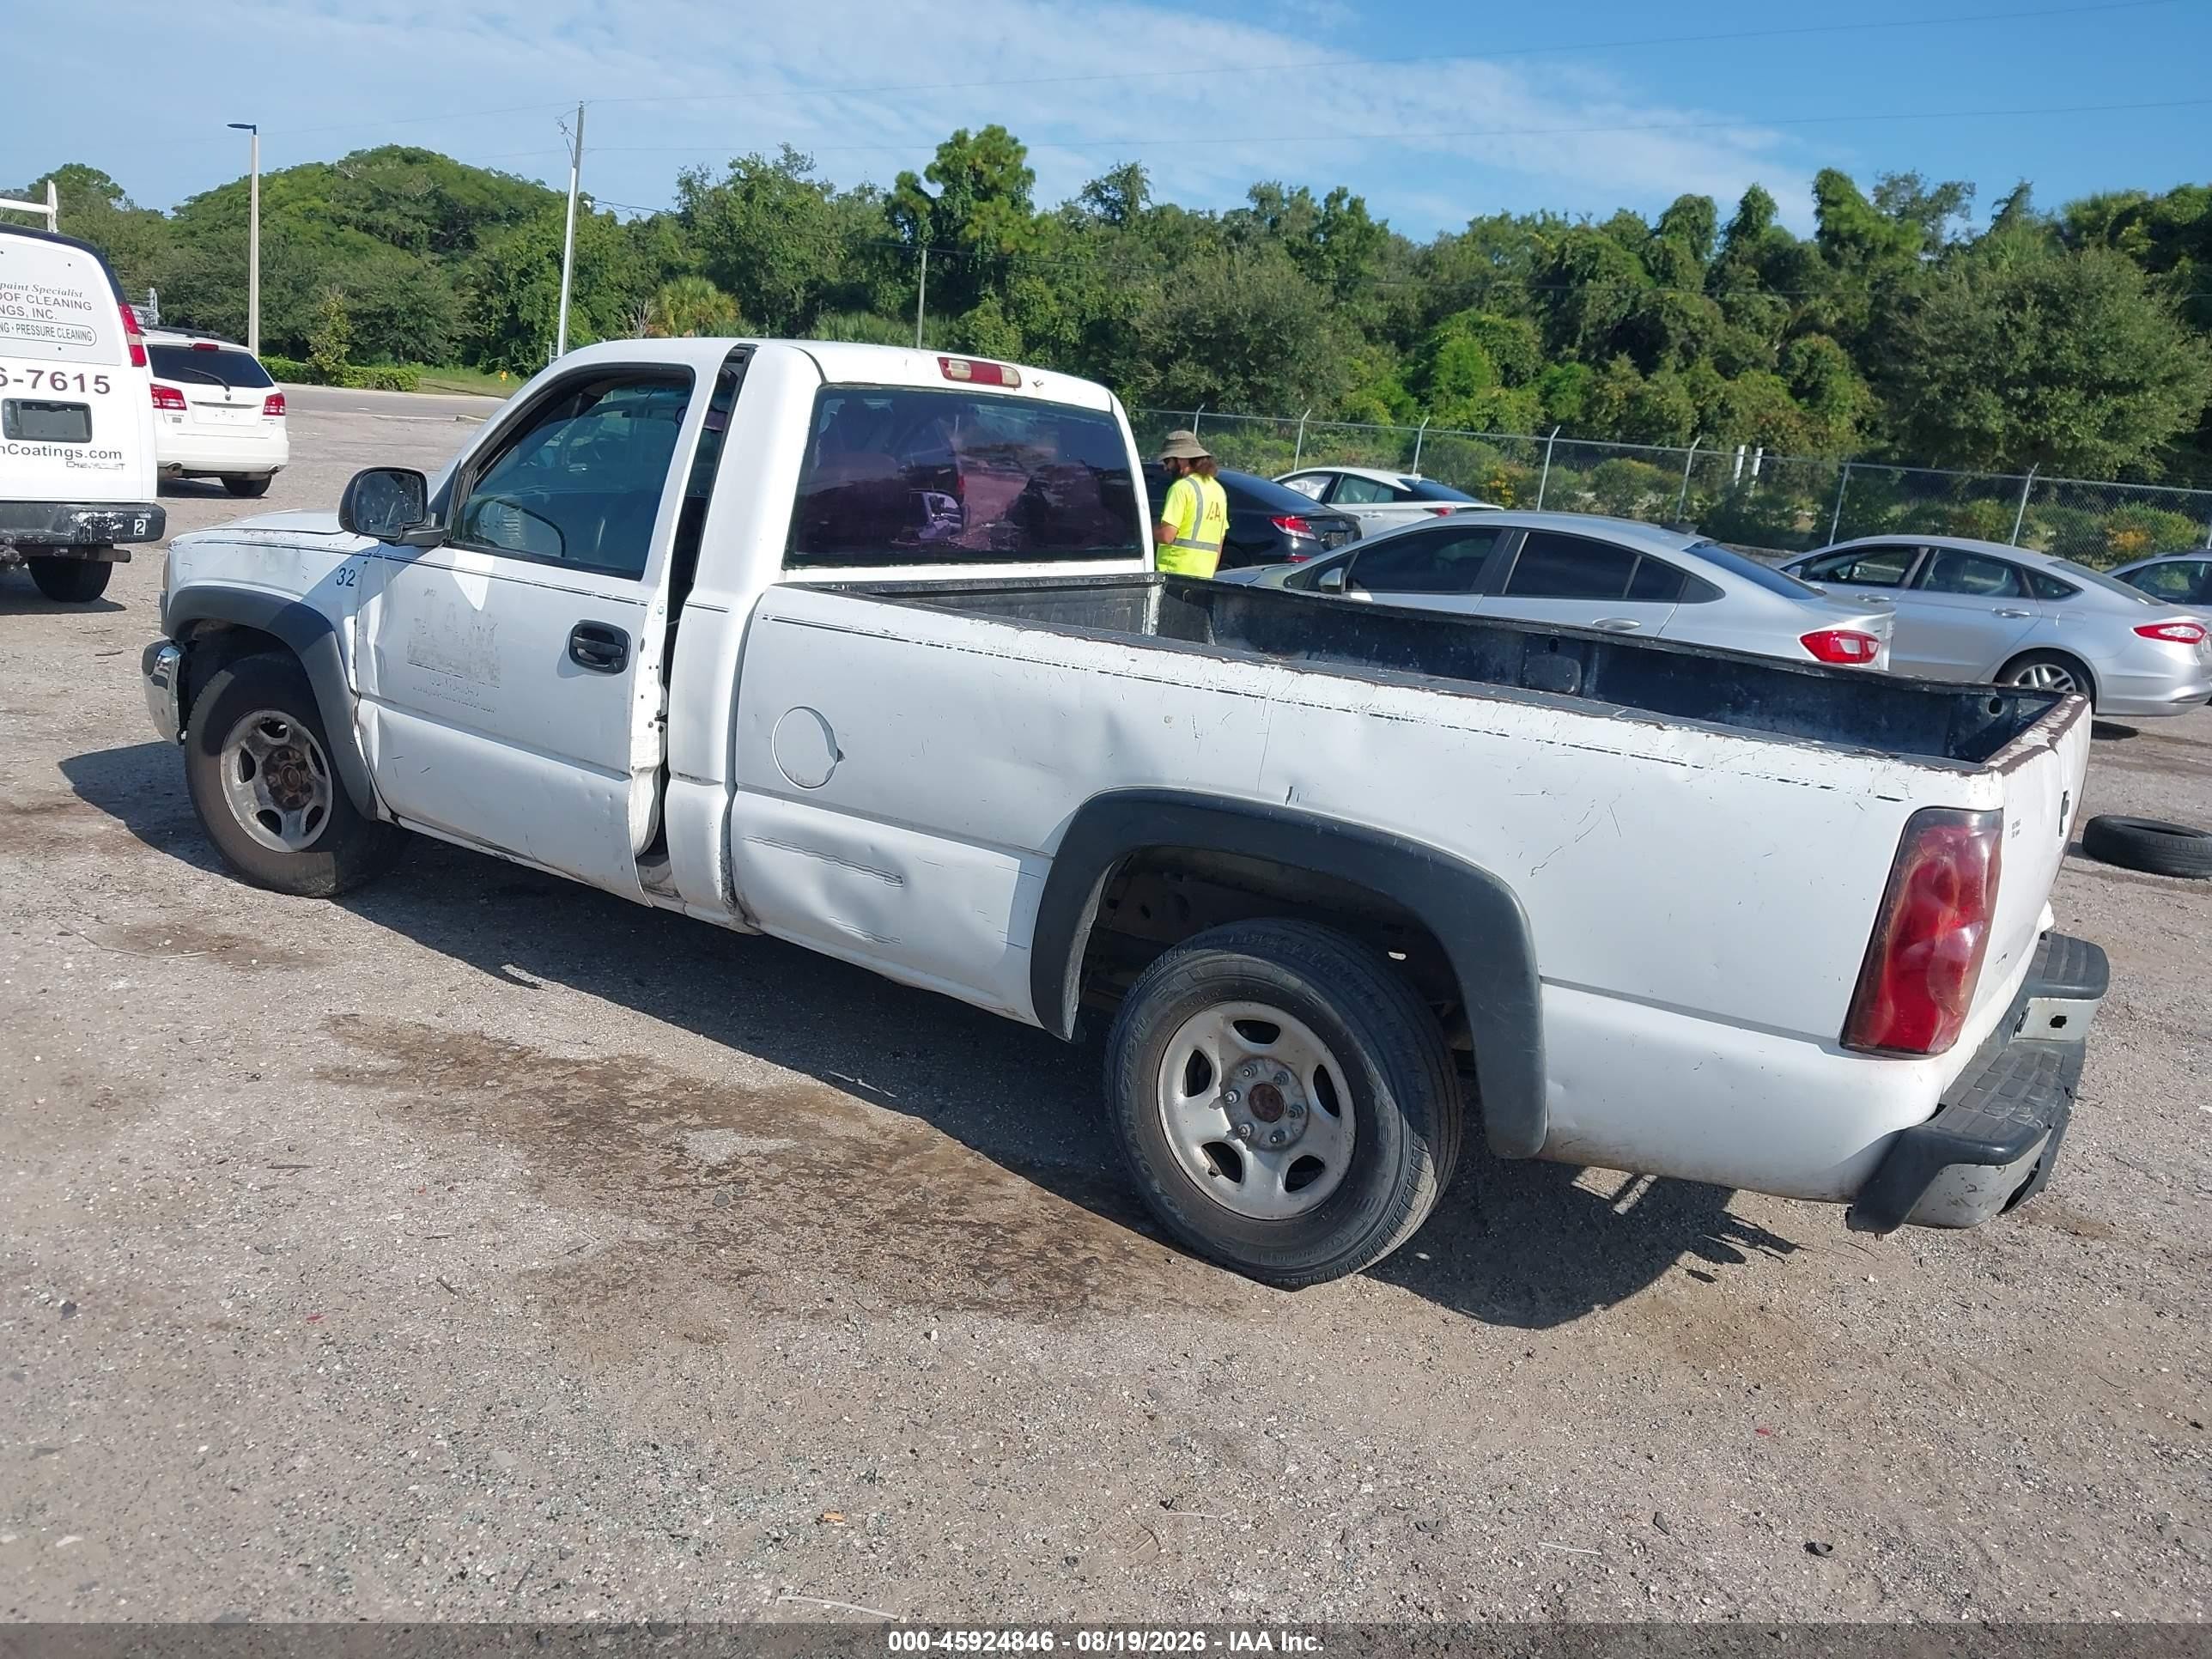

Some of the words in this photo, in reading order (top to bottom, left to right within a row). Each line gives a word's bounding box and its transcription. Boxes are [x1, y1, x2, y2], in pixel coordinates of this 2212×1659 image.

[32, 284, 83, 298] Specialist
[0, 291, 21, 302] OF
[27, 295, 92, 311] CLEANING
[32, 307, 58, 320] INC.
[15, 323, 56, 337] PRESSURE
[57, 327, 93, 342] CLEANING
[135, 520, 144, 534] 2
[336, 567, 356, 587] 32
